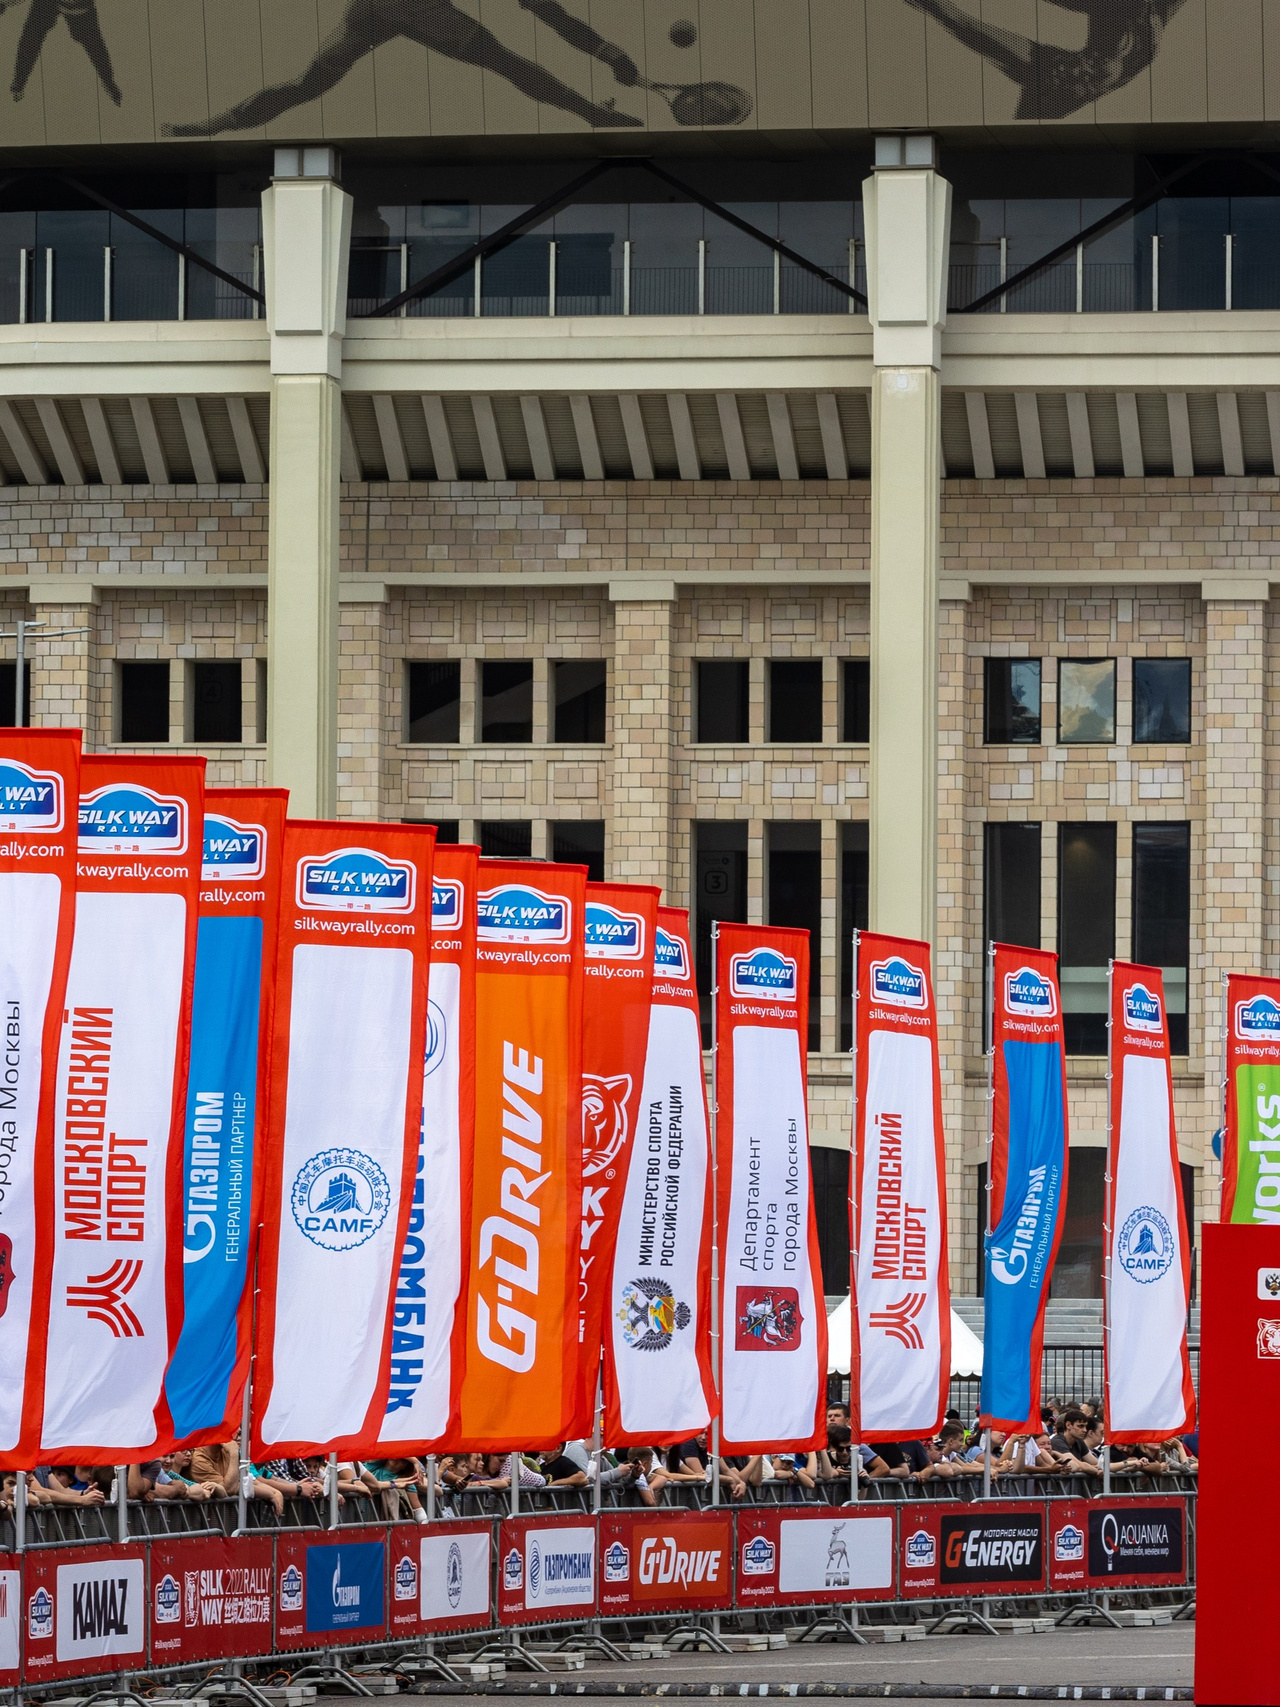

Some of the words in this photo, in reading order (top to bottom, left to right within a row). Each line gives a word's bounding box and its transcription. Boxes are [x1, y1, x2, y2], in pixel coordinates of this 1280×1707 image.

[5, 787, 51, 802] WAY
[78, 810, 126, 825] SILK
[128, 811, 175, 825] WAY
[97, 825, 151, 833] RALLY
[210, 838, 255, 853] WAY
[308, 869, 359, 885] SILK
[361, 872, 405, 887] WAY
[331, 885, 382, 893] RALLY
[477, 905, 518, 918] SILK
[520, 906, 560, 919] WAY
[494, 918, 540, 926] RALLY
[294, 917, 415, 937] silkwayrally.com
[590, 924, 635, 936] WAY
[656, 945, 680, 957] WAY
[738, 965, 767, 977] SILK
[769, 968, 793, 978] WAY
[753, 977, 783, 985] RALLY
[876, 972, 900, 984] SILK
[899, 977, 921, 988] WAY
[1010, 983, 1029, 995] SILK
[869, 1009, 931, 1026] silkwayrally.com
[1142, 1001, 1157, 1013] WAY
[1242, 1011, 1266, 1021] SILK
[63, 1006, 114, 1242] МОСКОВСКИЙ
[230, 1092, 246, 1155] ПАРТНЕР
[648, 1101, 663, 1153] СПОРТА
[667, 1085, 684, 1170] ФЕДЕРАЦИИ
[187, 1091, 225, 1212] ГАЗПРОМ
[784, 1118, 799, 1195] Москвы
[106, 1132, 148, 1242] СПОРТ
[871, 1112, 902, 1280] МОСКОВСКИЙ
[225, 1160, 243, 1262] ГЕНЕРАЛЬНЫЙ
[638, 1157, 661, 1267] МИНИСТЕРСТВО
[740, 1136, 762, 1271] Департамент
[1013, 1164, 1046, 1250] ГАЗПРОМ
[304, 1217, 373, 1233] CAMF
[660, 1174, 679, 1267] РОССИЙСКОЙ
[1029, 1214, 1052, 1289] ГЕНЕРАЛЬНЫЙ
[1045, 1165, 1059, 1213] ПАРТНЕР
[763, 1203, 779, 1271] спорта
[783, 1202, 801, 1271] города
[902, 1203, 927, 1280] СПОРТ
[1126, 1258, 1166, 1270] CAMF
[1120, 1524, 1169, 1545] AQUANIKA
[545, 1553, 592, 1581] ГАЗПРОМБАНК
[200, 1569, 224, 1597] SILK
[225, 1569, 243, 1595] 2022
[243, 1567, 270, 1593] RALLY
[825, 1571, 850, 1587] ГАЗ
[73, 1579, 128, 1641] KAMAZ
[200, 1599, 224, 1626] WAY
